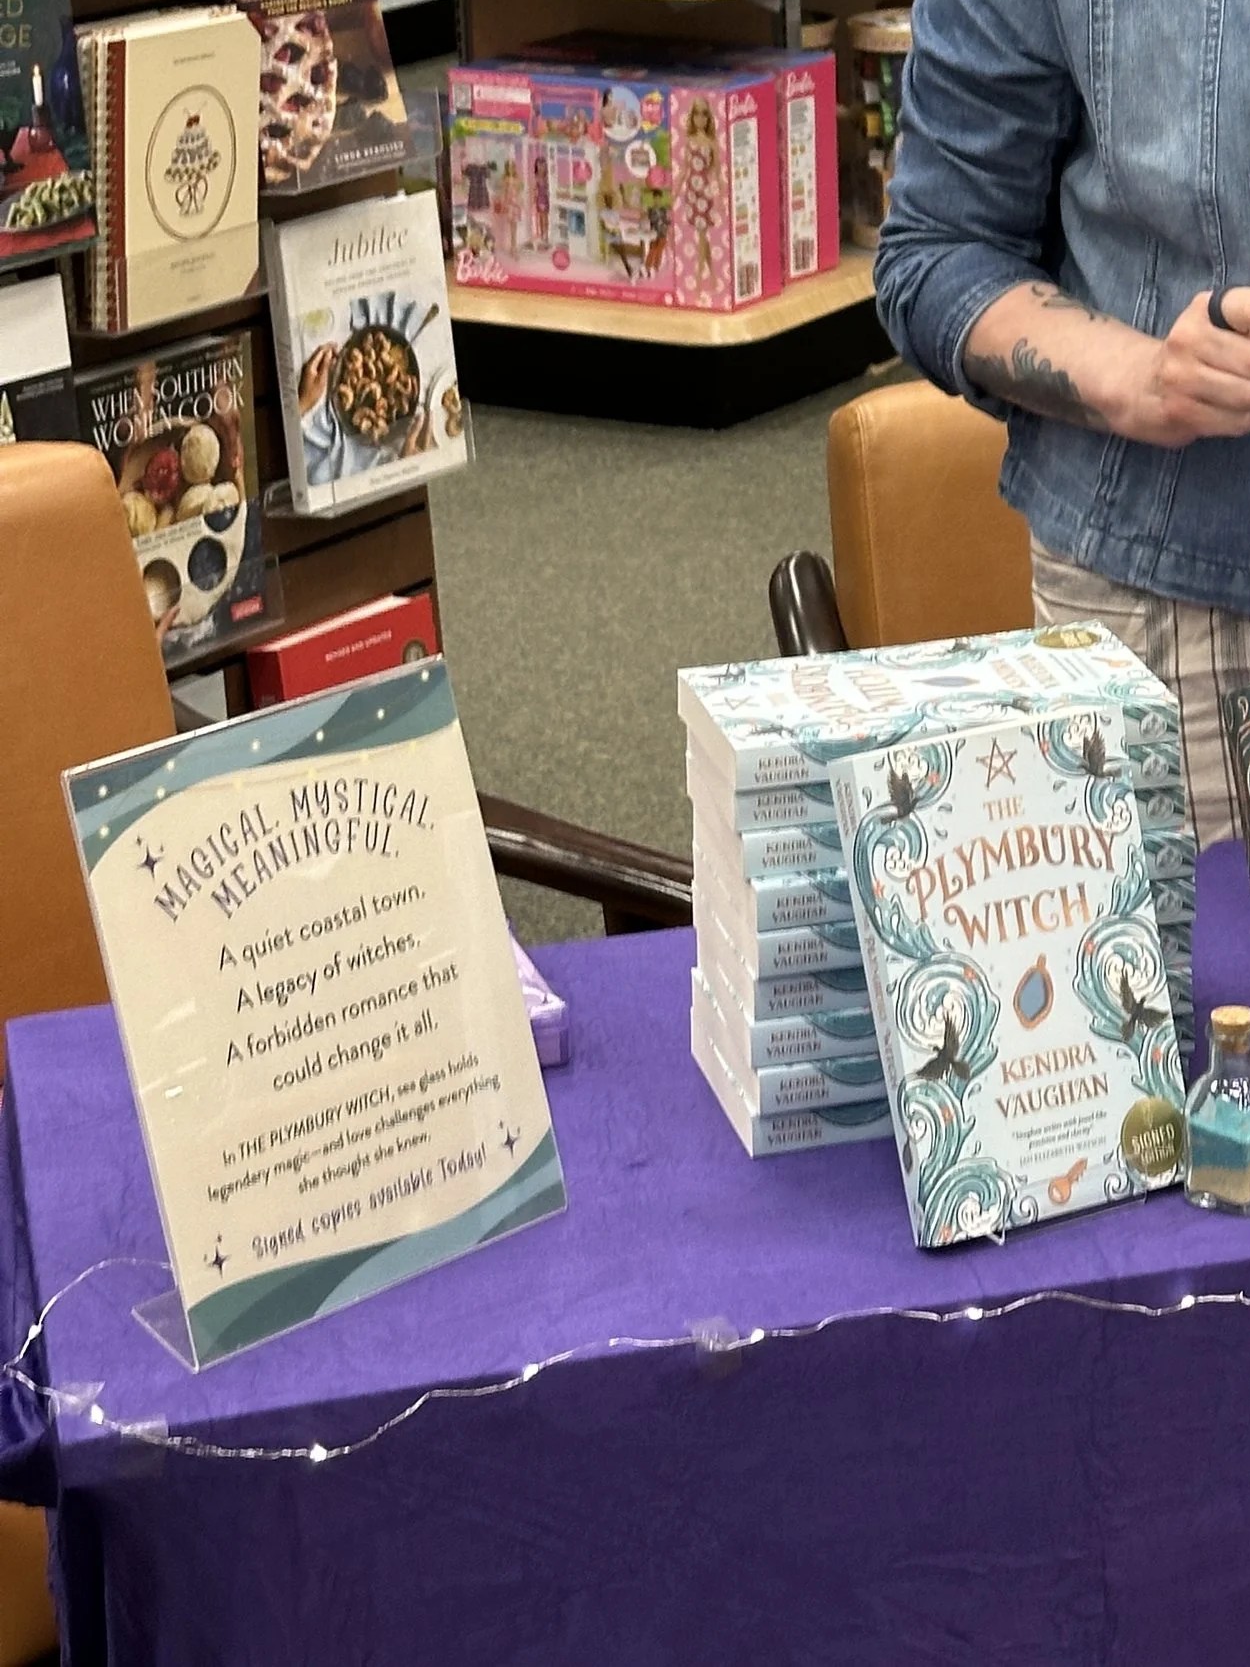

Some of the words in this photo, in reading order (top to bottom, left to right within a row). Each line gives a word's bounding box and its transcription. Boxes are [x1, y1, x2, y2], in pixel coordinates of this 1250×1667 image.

[327, 221, 408, 267] Jubilee
[91, 387, 145, 423] WHEN
[153, 354, 244, 403] SOUTHERN
[178, 382, 245, 423] COOK
[753, 765, 810, 784] VAUGHAN
[757, 753, 806, 771] KENDRA
[982, 794, 1027, 822] THE
[153, 801, 282, 924] MAGICAL.
[210, 819, 400, 921] MEANINGFUL.
[761, 850, 818, 869] VAUGHAN
[764, 836, 814, 856] KENDRA
[904, 822, 1119, 924] PLYMBURY
[218, 943, 239, 973] A
[241, 929, 295, 970] quiet
[299, 902, 368, 941] coastal
[371, 883, 426, 918] town.
[942, 881, 1092, 950] WITCH
[237, 988, 254, 1014] A
[256, 968, 317, 1008] legacy
[322, 955, 343, 980] of
[346, 930, 421, 975] witches.
[772, 950, 829, 970] VAUGHAN
[776, 937, 825, 957] KENDRA
[227, 1040, 244, 1067] A
[246, 1007, 337, 1055] forbidden
[341, 980, 419, 1023] romance
[421, 962, 460, 992] that
[272, 1052, 324, 1092] could
[326, 1034, 392, 1069] change
[395, 1023, 410, 1045] it
[412, 1010, 438, 1037] all.
[1000, 1042, 1099, 1085] KENDRA
[222, 1147, 236, 1167] In
[238, 1138, 266, 1163] THE
[269, 1105, 344, 1151] PLYMBURY
[346, 1088, 395, 1119] WITCH,
[397, 1080, 416, 1099] sea
[418, 1067, 447, 1096] glass
[447, 1054, 480, 1080] holds
[774, 1087, 831, 1106] VAUGHAN
[778, 1074, 827, 1093] KENDRA
[995, 1073, 1110, 1120] VAUGHAN
[207, 1168, 271, 1204] legendary
[345, 1124, 372, 1148] love
[374, 1099, 436, 1141] challenges
[437, 1073, 502, 1108] everything
[297, 1175, 319, 1195] she
[322, 1154, 371, 1189] thought
[373, 1144, 395, 1163] she
[397, 1131, 432, 1153] knew.
[251, 1221, 305, 1259] Signed
[311, 1199, 362, 1237] copies
[369, 1168, 433, 1212] available
[436, 1140, 488, 1184] Today!
